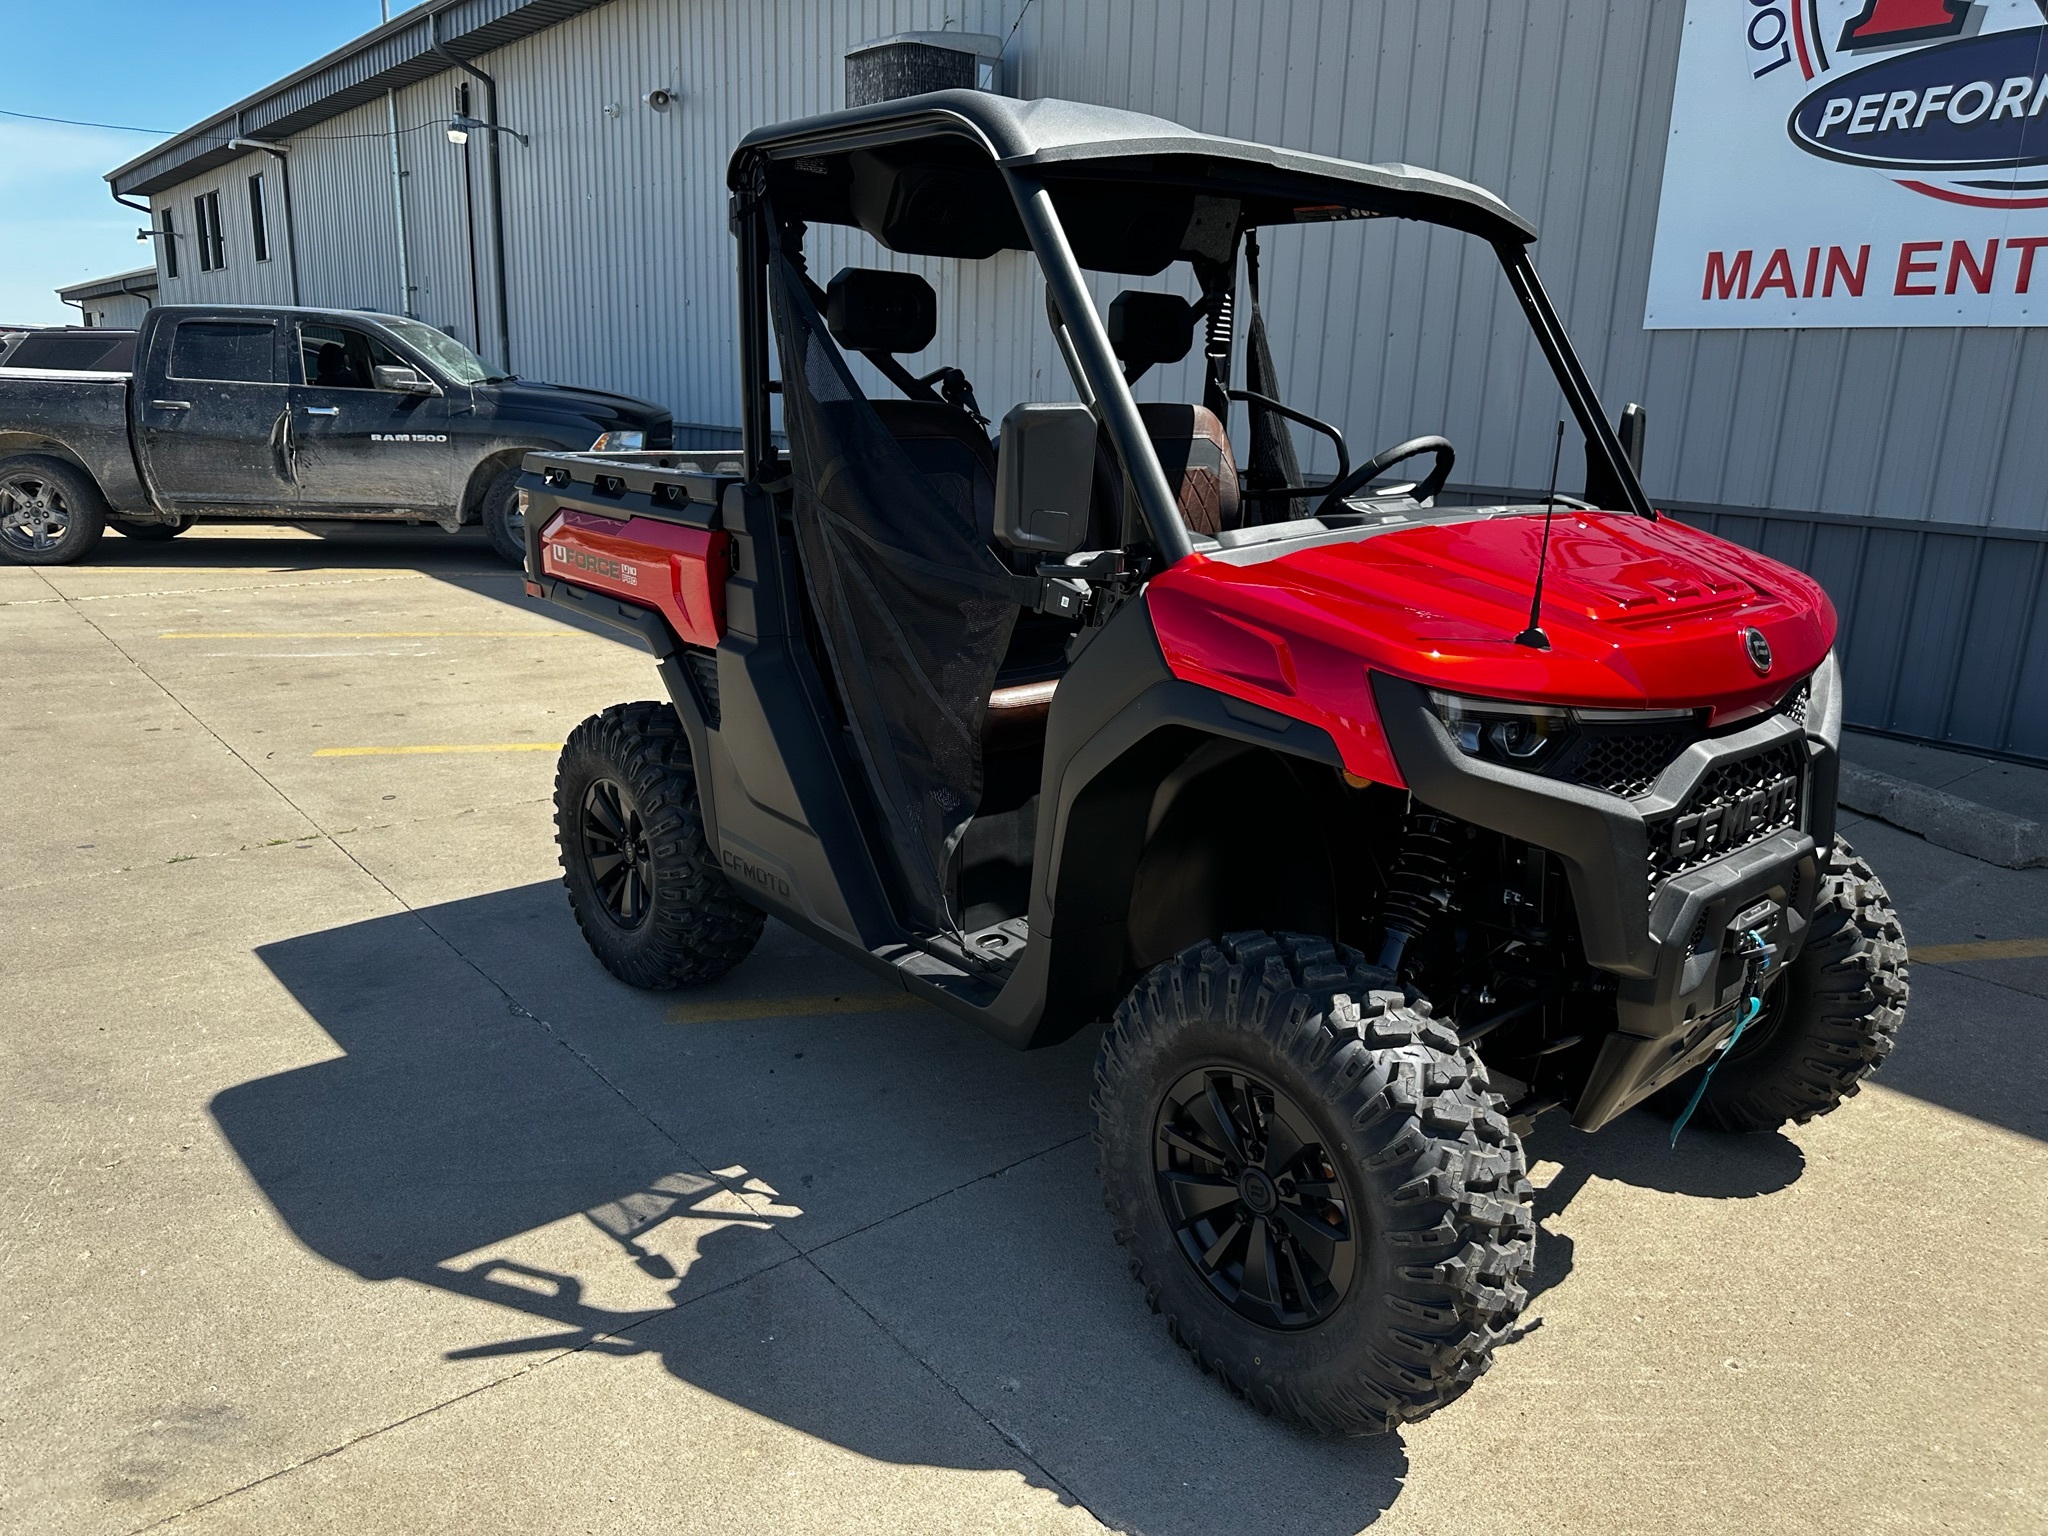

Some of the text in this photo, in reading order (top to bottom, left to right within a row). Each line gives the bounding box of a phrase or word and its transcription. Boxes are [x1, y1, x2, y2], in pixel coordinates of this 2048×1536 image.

[1702, 244, 1871, 300] MAIN
[412, 434, 447, 442] 1500
[621, 573, 637, 586] PRO
[1671, 775, 1798, 858] CFMOTO
[723, 850, 790, 897] CFMOTO
